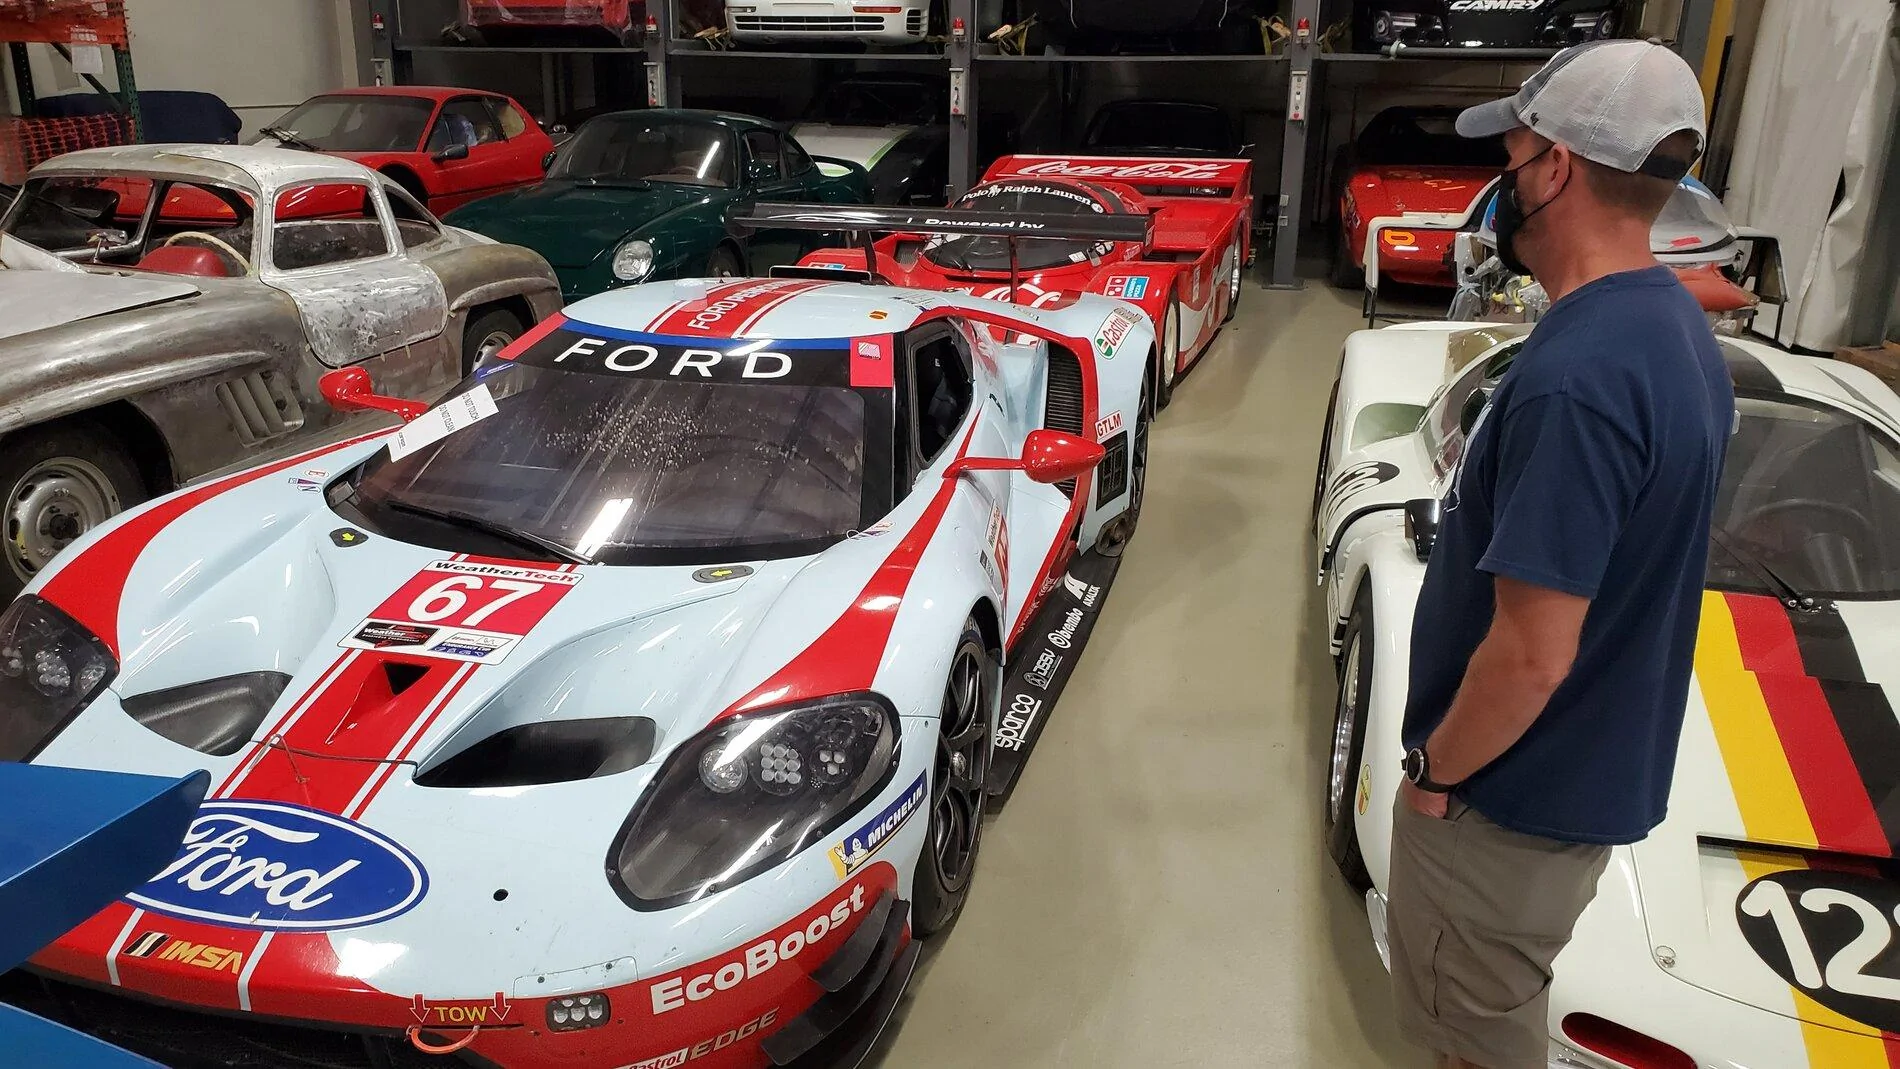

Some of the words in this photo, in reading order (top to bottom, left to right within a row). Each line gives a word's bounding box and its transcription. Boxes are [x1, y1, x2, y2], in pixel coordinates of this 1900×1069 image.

[1450, 0, 1544, 11] CAMRY
[962, 189, 989, 202] Polo
[1002, 184, 1042, 195] Ralph
[1043, 186, 1092, 206] Lauren
[687, 299, 739, 330] FORD
[1102, 314, 1132, 347] Castrol
[553, 338, 793, 380] FORD
[1097, 413, 1122, 437] GTLM
[435, 561, 574, 583] WeatherTech
[407, 575, 545, 628] 67
[1083, 585, 1101, 608] AXALTA
[1054, 608, 1084, 642] brembo
[994, 694, 1035, 749] sparco
[867, 783, 923, 848] MICHELIN
[148, 814, 362, 911] Ford
[159, 939, 243, 975] IMSA
[650, 883, 865, 1015] EcoBoost
[1741, 880, 1900, 1001] 12
[434, 1005, 487, 1023] TOW
[690, 1006, 780, 1061] EDGE
